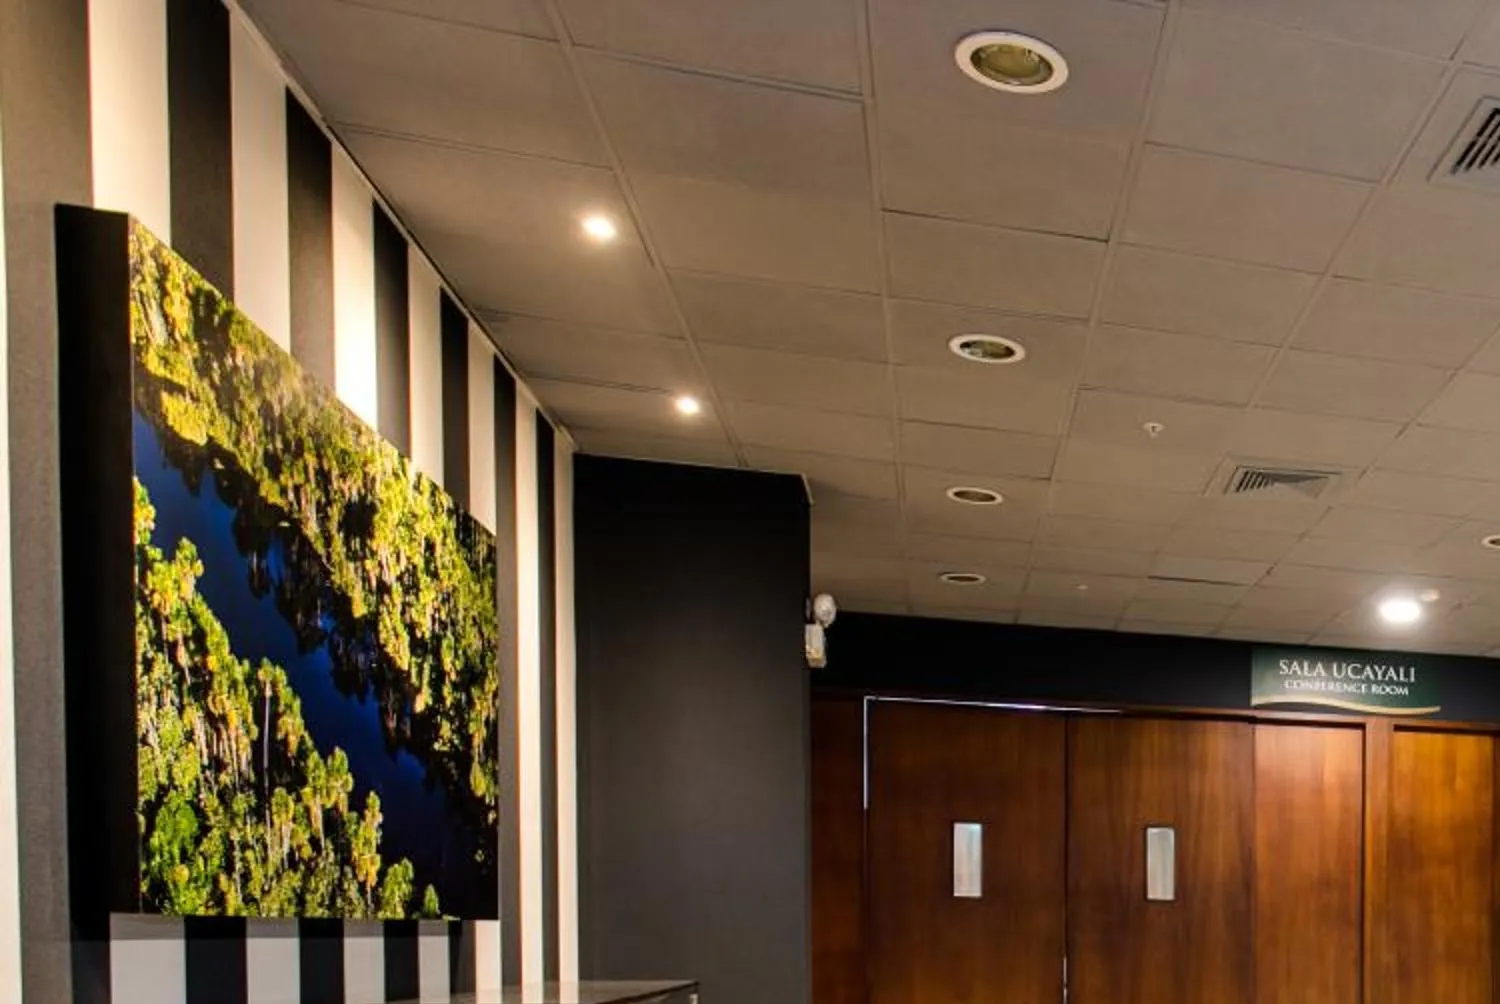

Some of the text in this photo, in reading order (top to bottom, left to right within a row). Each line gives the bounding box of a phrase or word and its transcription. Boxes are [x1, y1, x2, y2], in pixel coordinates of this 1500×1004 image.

[1279, 659, 1415, 683] SALA UCAYALI
[1284, 680, 1409, 696] CONFERENCE ROOM
